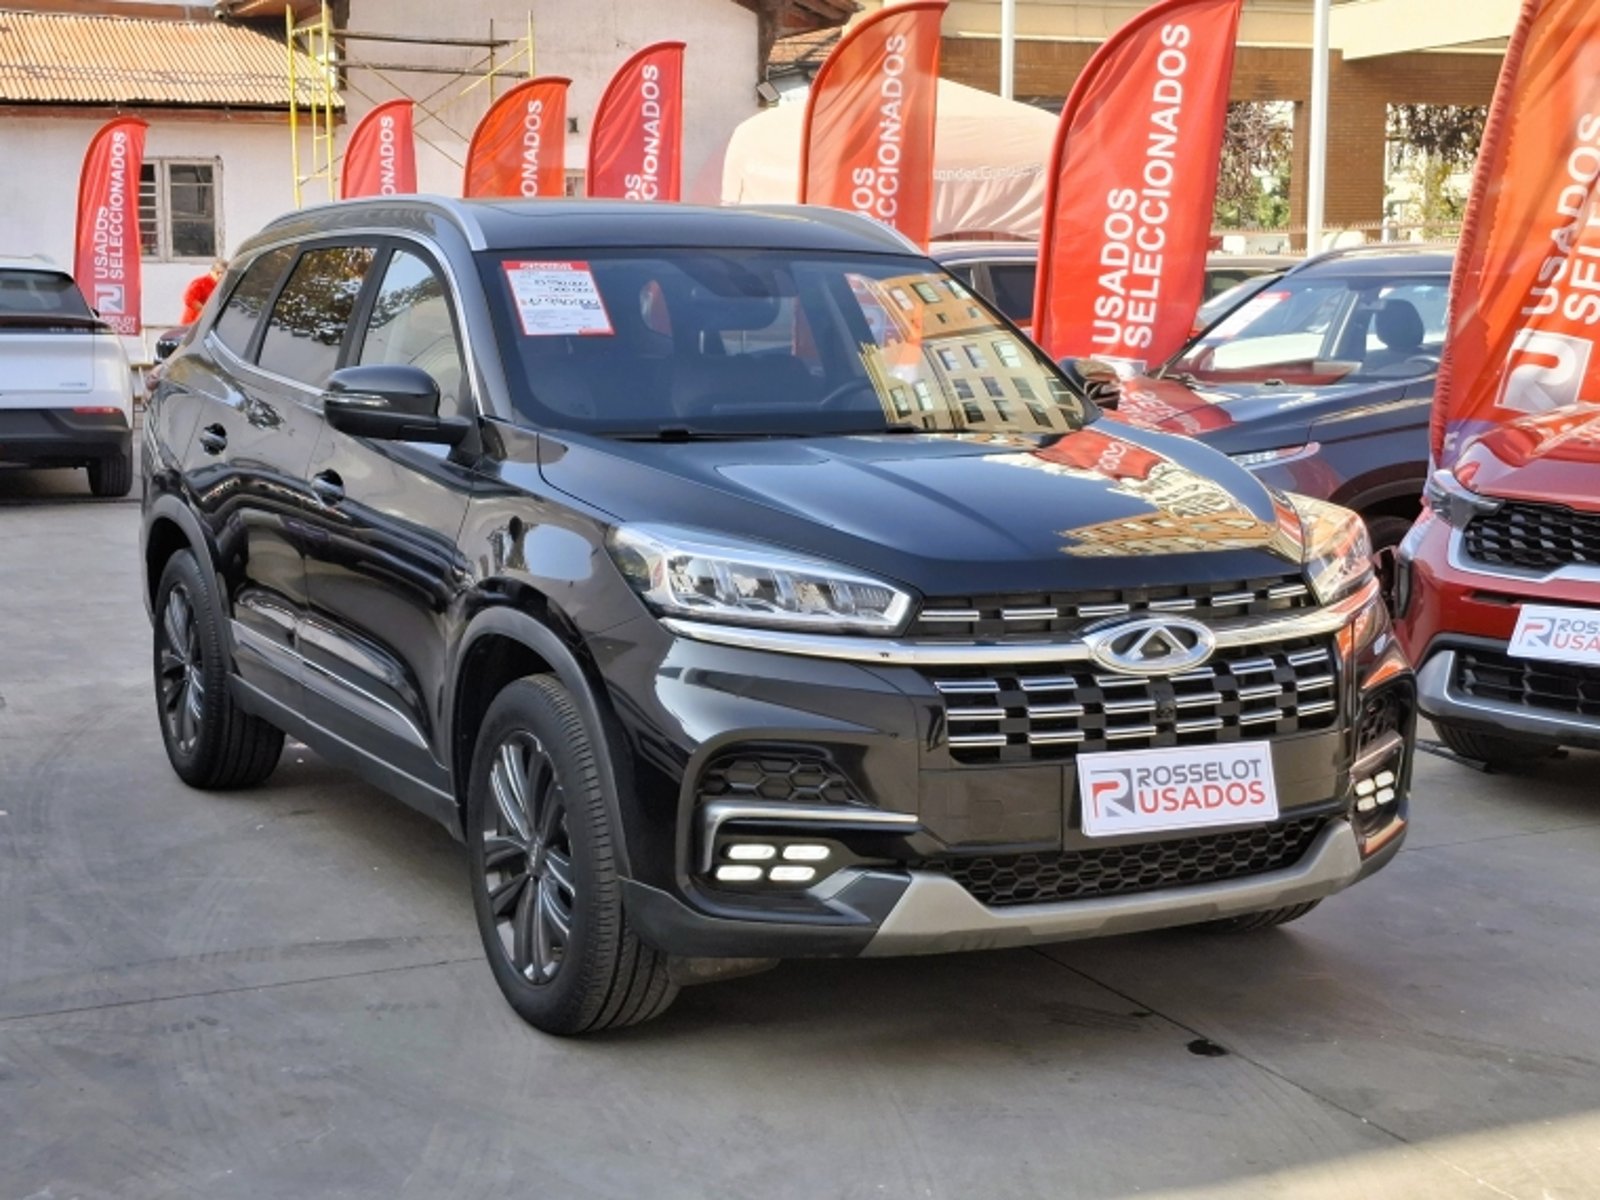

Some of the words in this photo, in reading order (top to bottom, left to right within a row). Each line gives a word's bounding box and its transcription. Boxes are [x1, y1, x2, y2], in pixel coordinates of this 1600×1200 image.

[108, 131, 127, 280] SELECCIONADOS
[1123, 23, 1191, 349] SELECCIONADOS
[94, 206, 109, 279] USADOS
[1091, 187, 1138, 345] USADOS
[1136, 758, 1262, 788] ROSSELOT
[1137, 779, 1267, 815] USADOS
